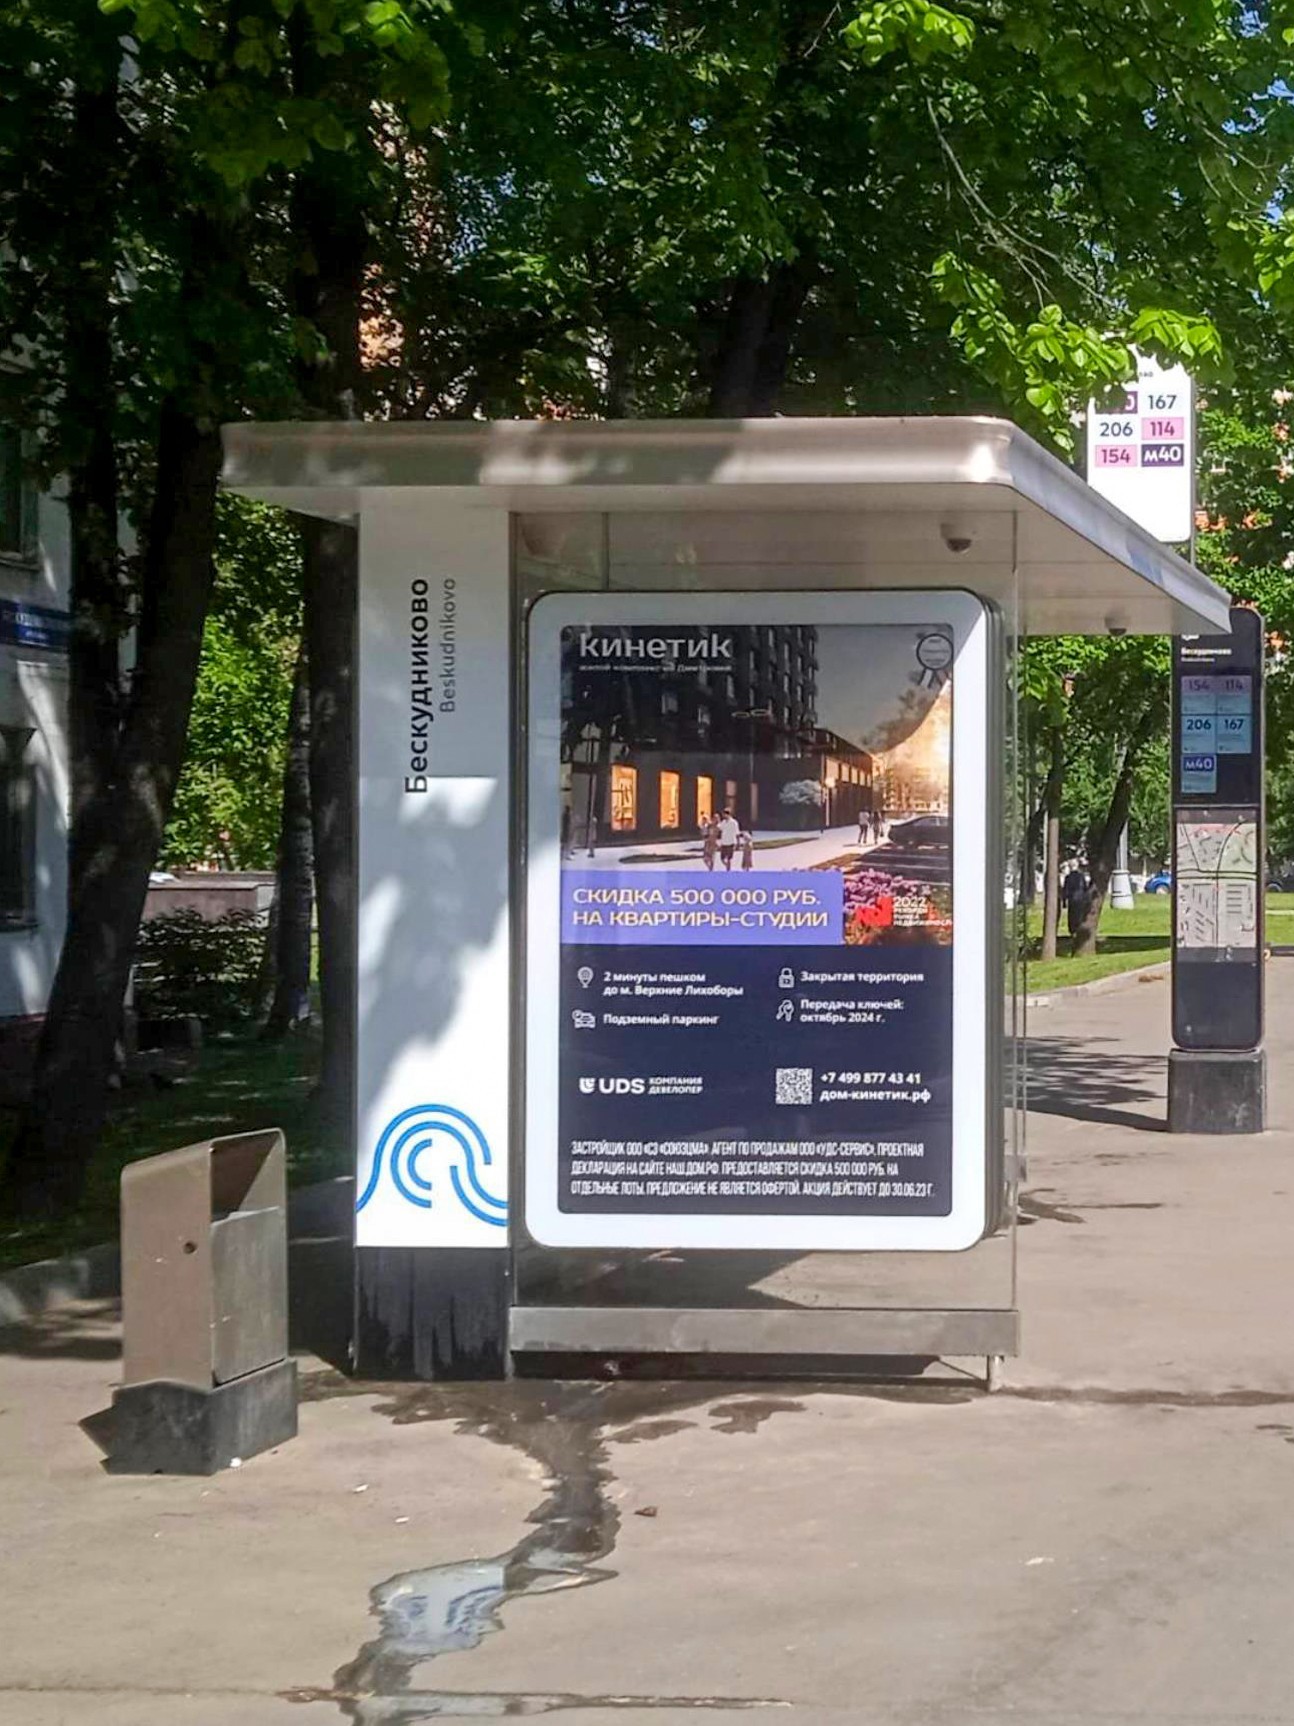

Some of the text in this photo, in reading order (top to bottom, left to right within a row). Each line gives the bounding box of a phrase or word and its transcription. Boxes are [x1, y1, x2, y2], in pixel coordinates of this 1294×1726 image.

[1147, 394, 1177, 410] 167
[1099, 421, 1133, 437] 206
[1150, 421, 1175, 436] 114
[1101, 448, 1131, 464] 154
[439, 578, 456, 712] Beskudnikovo
[404, 578, 434, 793] Бескудниково
[1189, 680, 1209, 691] 154
[1225, 679, 1243, 692] 114
[1186, 719, 1211, 730] 206
[1224, 719, 1244, 731] 167
[573, 888, 821, 906] СКИДКА 500 000 РУБ.
[893, 896, 928, 907] 2022
[573, 911, 828, 930] НА КВАРТИРЫ-СТУДИИ
[603, 972, 706, 984] 2 минуты пешком
[800, 971, 924, 984] Закрытая территория
[603, 985, 744, 998] до м. Верхние Лихоборы
[800, 1000, 904, 1011] Передача ключей:
[603, 1013, 719, 1025] Подземный паркинг
[800, 1012, 846, 1024] октябрь
[848, 1013, 874, 1023] 2024
[649, 1077, 703, 1085] КОМПАНИЯ
[820, 1072, 921, 1084] +7 499 877 43 41
[599, 1078, 645, 1094] UDS
[648, 1085, 703, 1095] ДЕВЕЛОПЕР
[819, 1089, 931, 1103] дом-кинетик.рф
[877, 1143, 924, 1156] ПРОЕКТНАЯ
[834, 1162, 850, 1175] 500
[851, 1162, 867, 1175] 000
[886, 1162, 898, 1175] НА
[802, 1181, 831, 1196] АКЦИЯ
[831, 1180, 878, 1197] ДЕЙСТВУЕТ
[878, 1182, 890, 1197] ДО
[891, 1182, 926, 1197] 30.06.23
